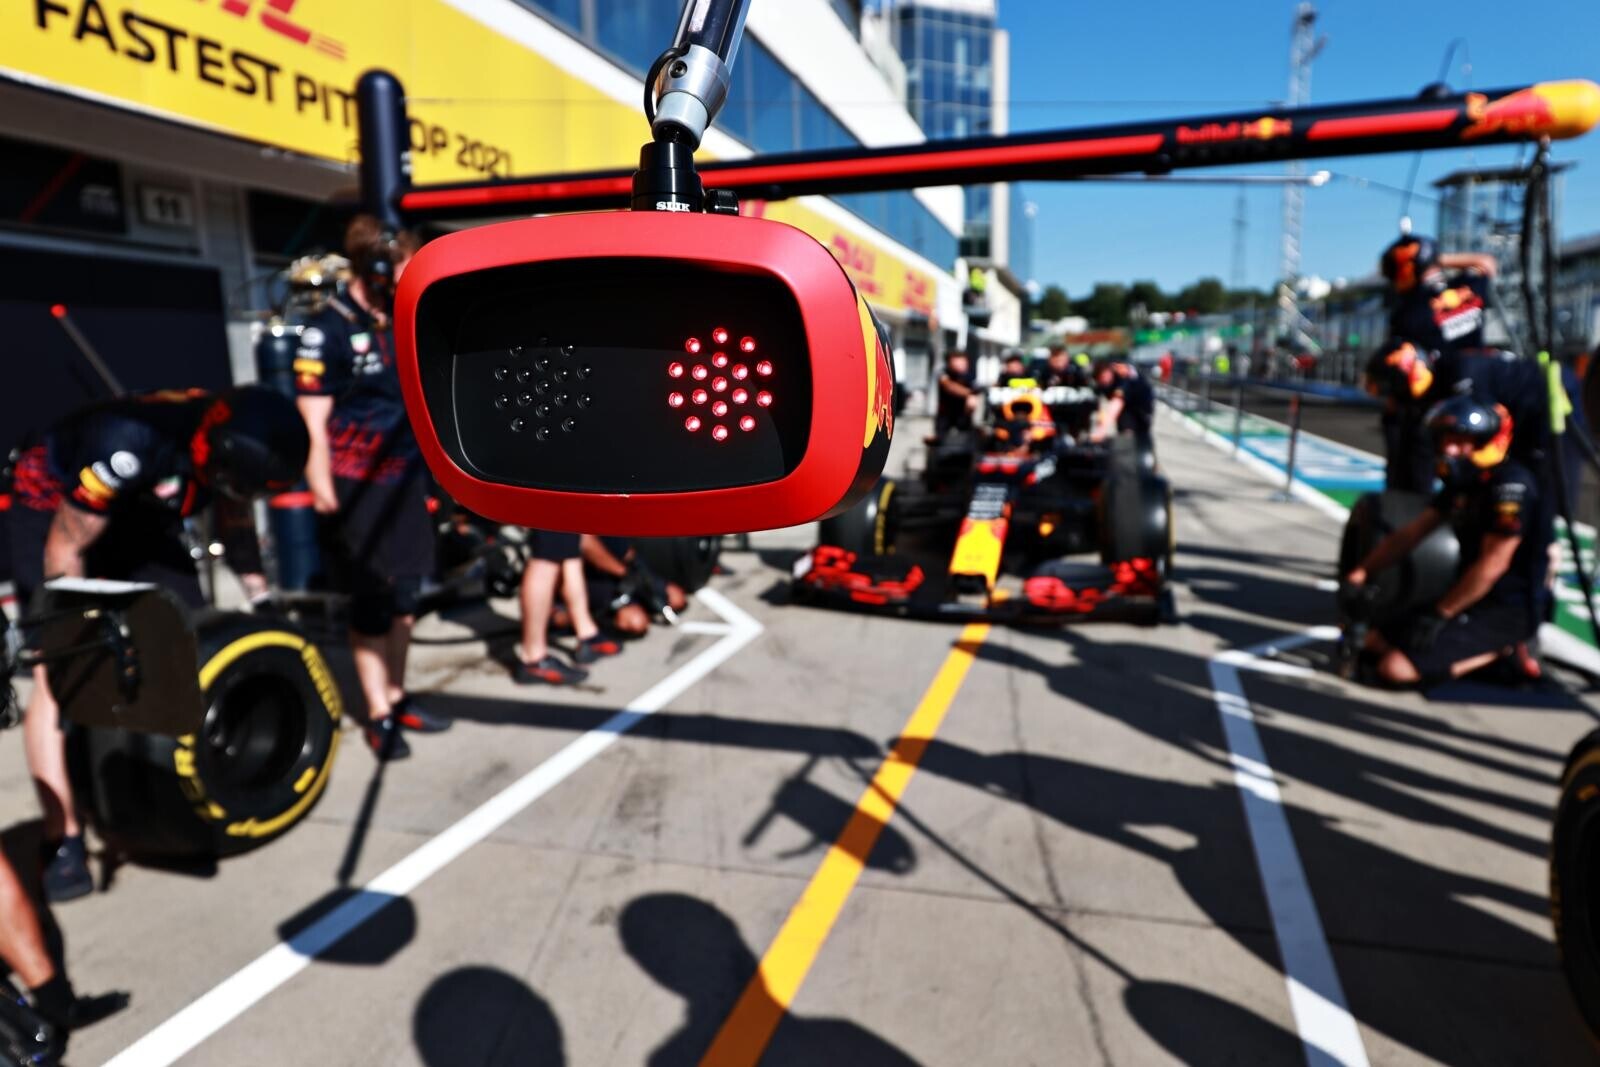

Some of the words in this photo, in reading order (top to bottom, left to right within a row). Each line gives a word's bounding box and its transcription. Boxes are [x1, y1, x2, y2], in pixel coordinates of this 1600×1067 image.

[34, 0, 282, 103] FASTEST
[294, 73, 358, 128] PIT
[408, 116, 448, 158] OP
[455, 133, 514, 179] 2021
